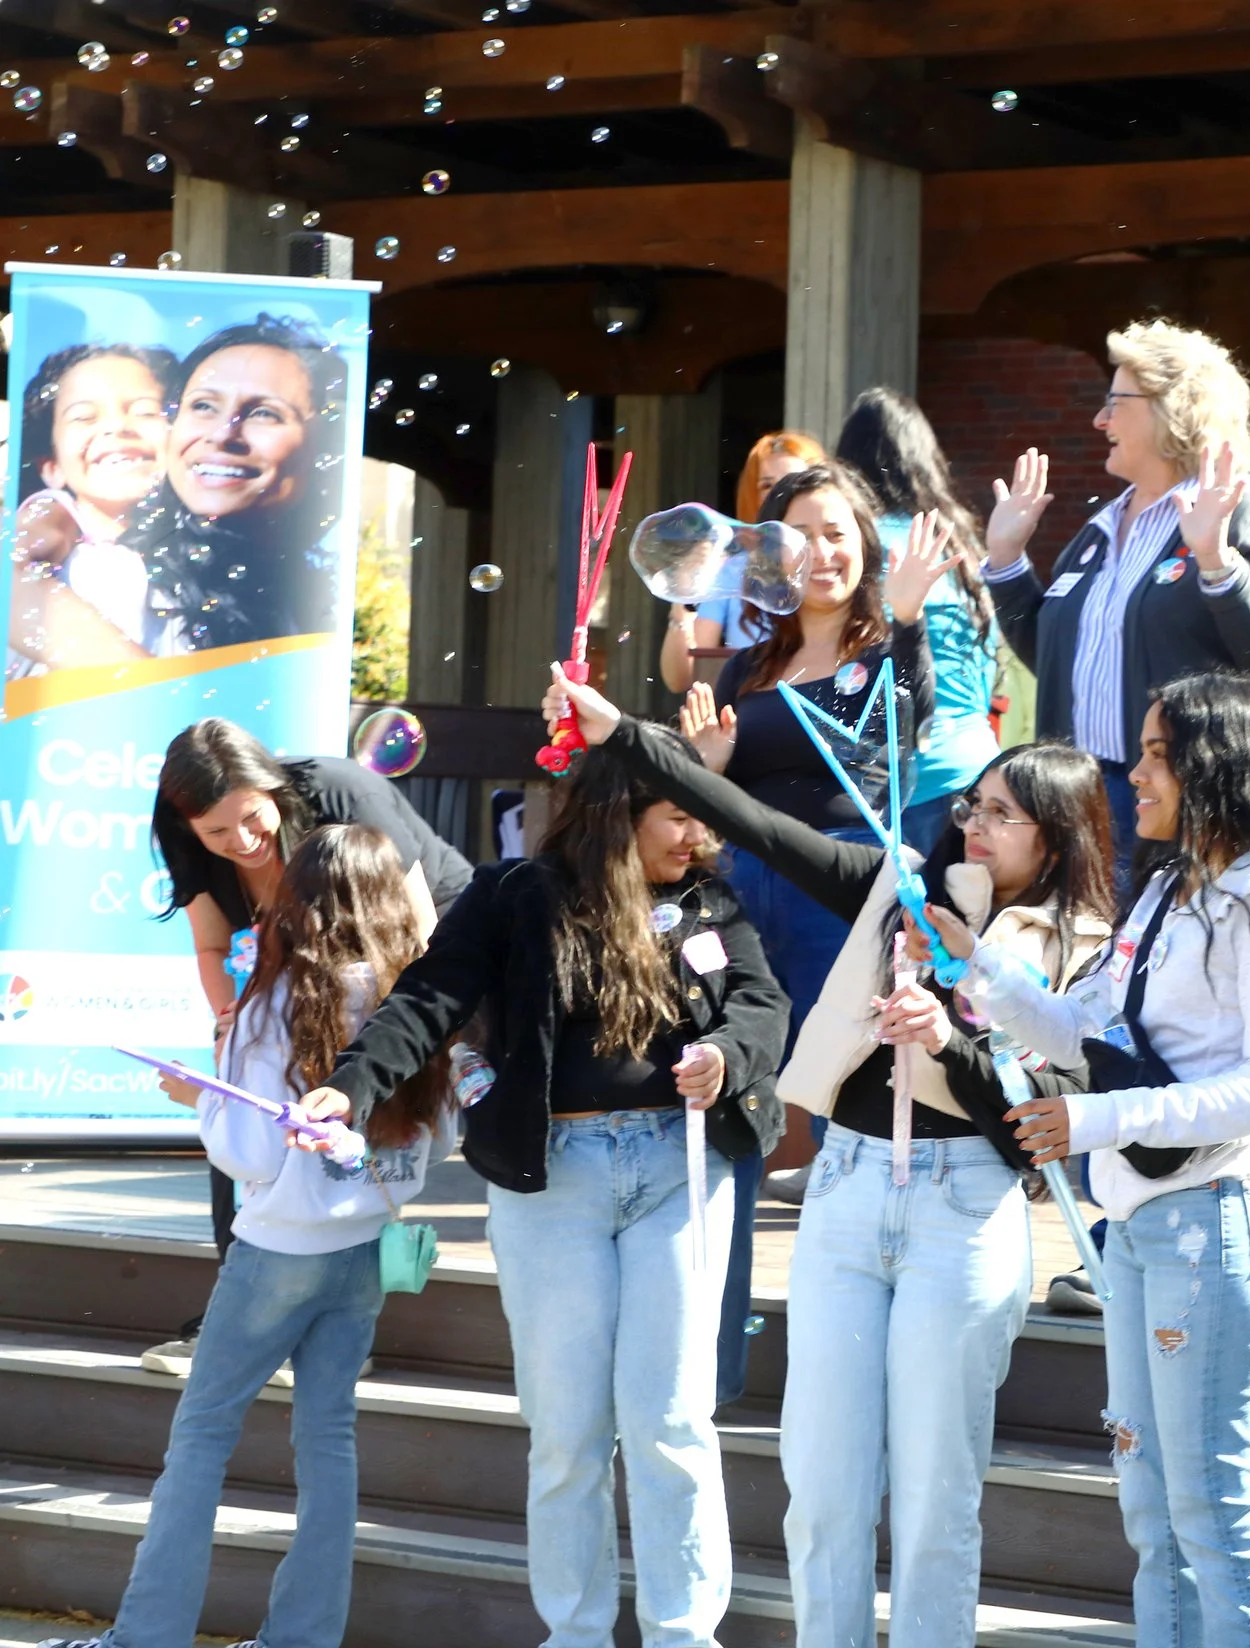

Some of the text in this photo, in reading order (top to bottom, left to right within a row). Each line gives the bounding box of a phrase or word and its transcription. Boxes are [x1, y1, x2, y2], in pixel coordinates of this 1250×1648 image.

[37, 738, 166, 790] Cele
[1, 799, 154, 850] Wom
[89, 870, 131, 914] &
